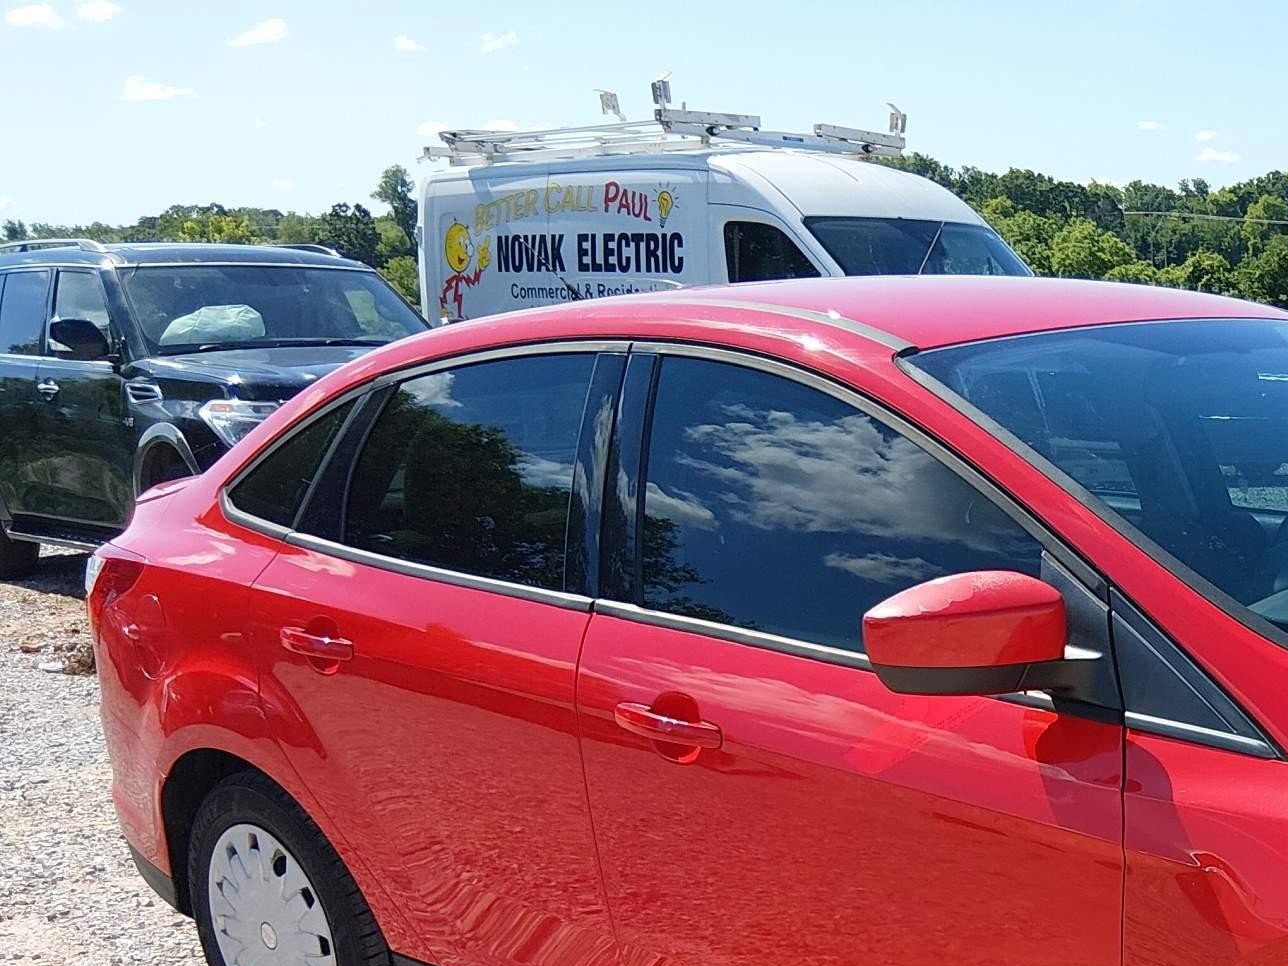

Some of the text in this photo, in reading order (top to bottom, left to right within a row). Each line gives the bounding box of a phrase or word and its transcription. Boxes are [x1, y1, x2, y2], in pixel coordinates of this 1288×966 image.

[474, 181, 652, 235] BETTER CALL PAUL
[496, 231, 685, 274] NOVAK ELECTRIC
[584, 283, 594, 299] &
